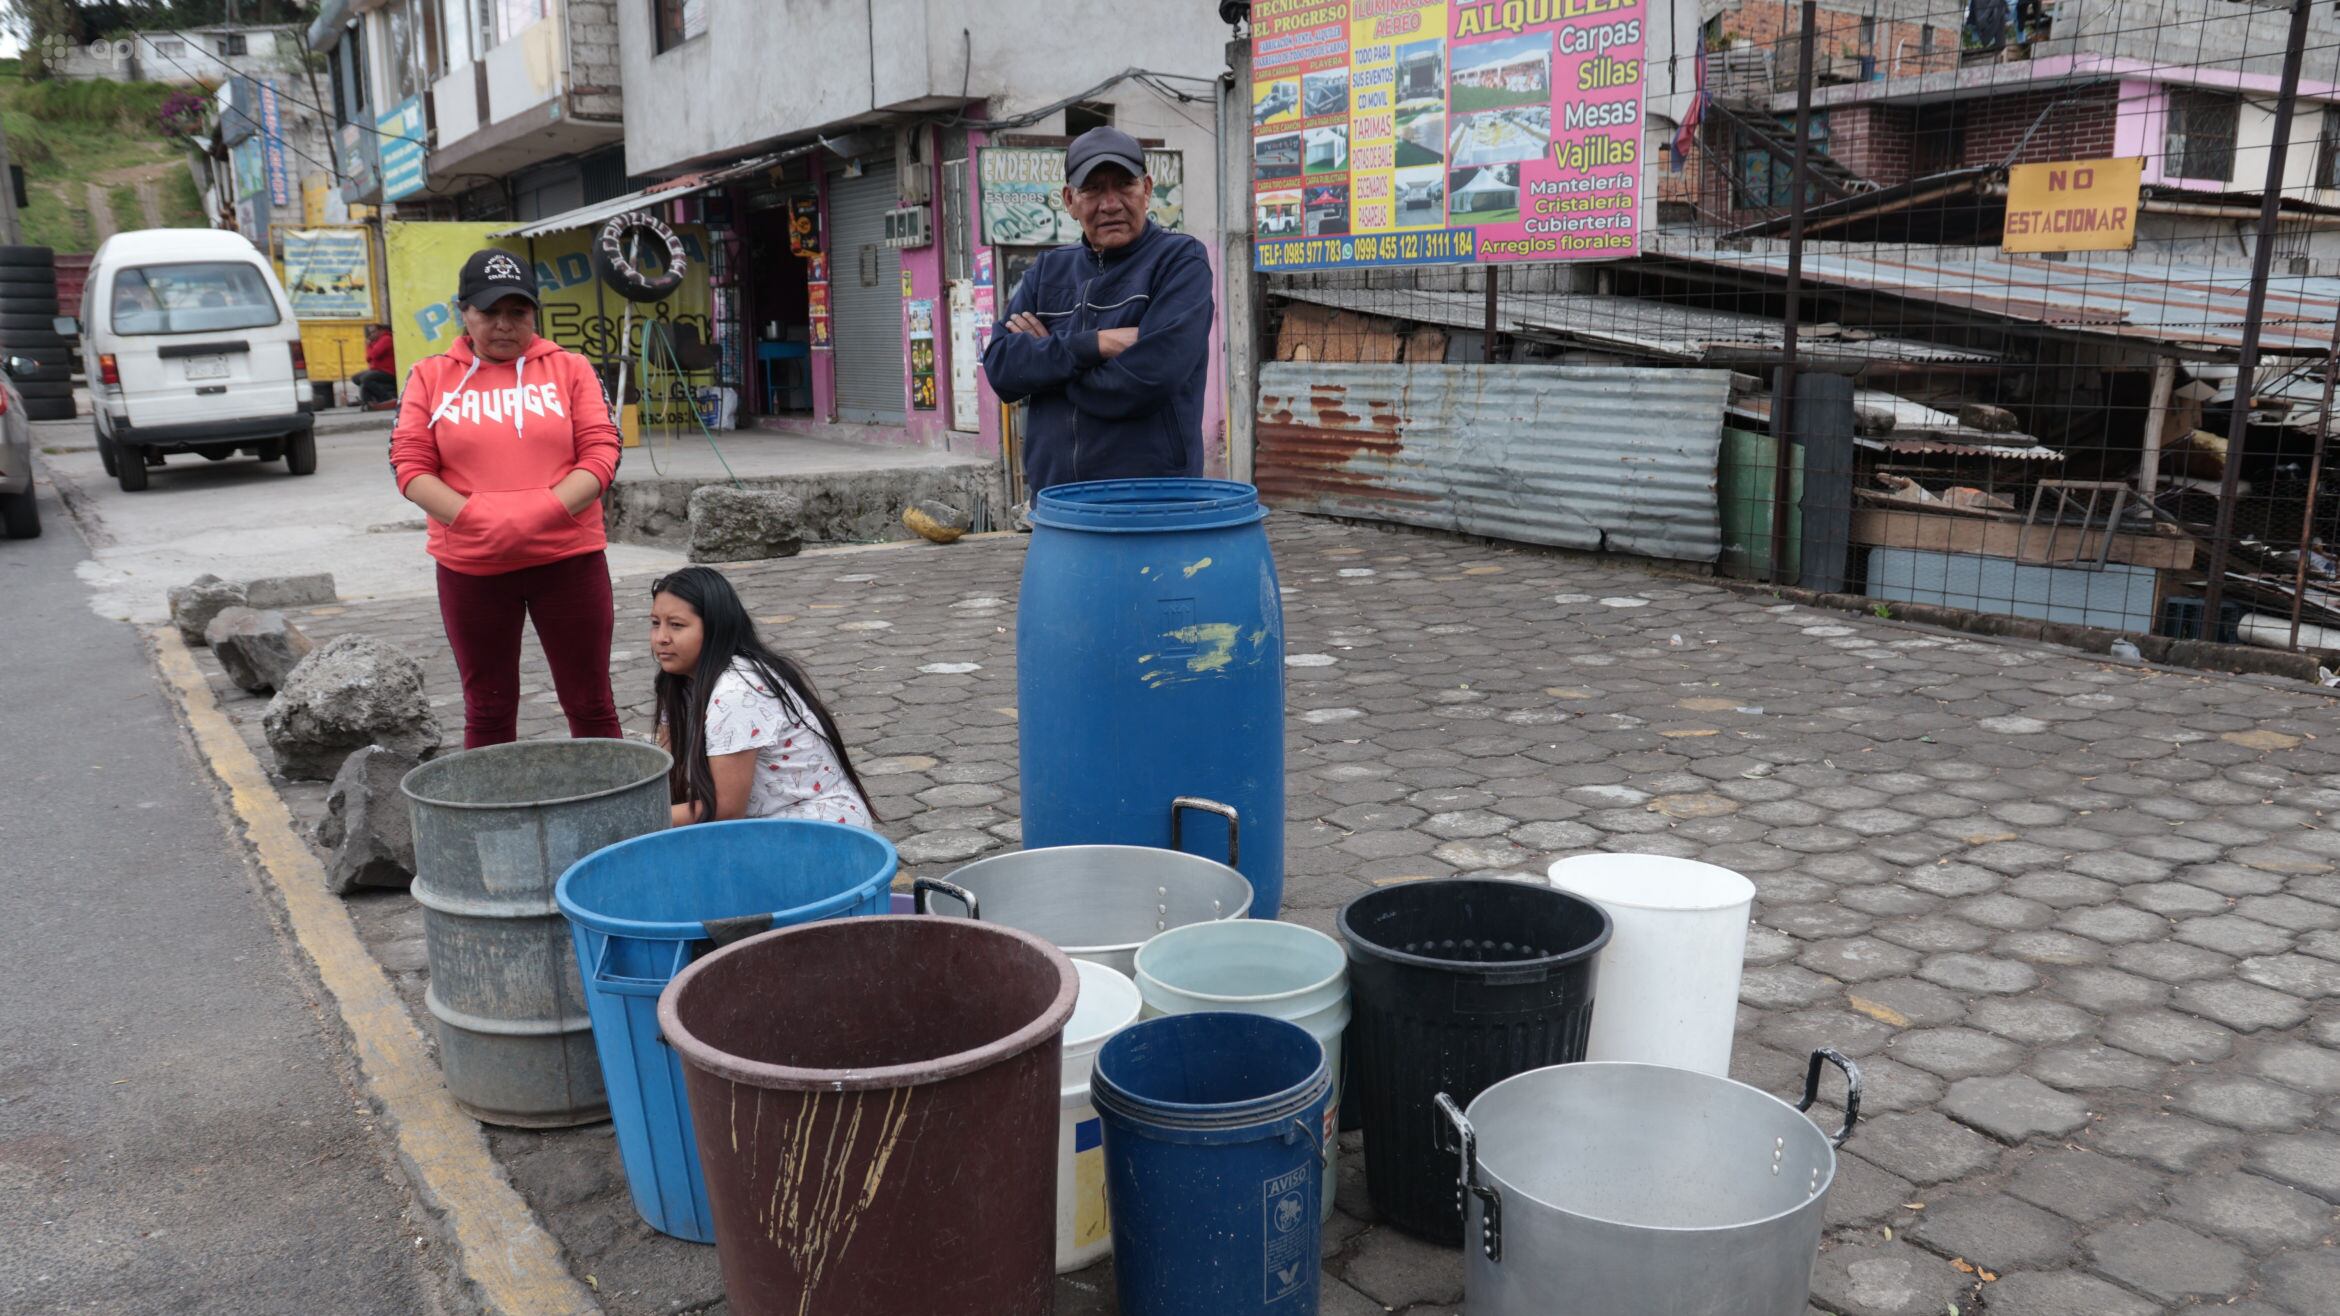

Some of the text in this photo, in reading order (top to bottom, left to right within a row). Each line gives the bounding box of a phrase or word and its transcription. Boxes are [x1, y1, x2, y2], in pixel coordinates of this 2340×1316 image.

[1253, 4, 1347, 38] EL PROGRESO
[1559, 19, 1641, 55] Carpas
[1310, 57, 1343, 69] PLAYERA
[1355, 44, 1391, 65] TODO PARA
[1352, 66, 1394, 88] SUS EVENTOS
[1578, 55, 1639, 91] Sillas
[1564, 99, 1637, 131] Mesas
[1353, 115, 1392, 140] TARIMAS
[1378, 144, 1392, 167] BAILE
[1553, 135, 1636, 174] Vajillas
[1357, 176, 1388, 199] ESCENARIOS
[1530, 172, 1633, 196] Mantelería
[2049, 168, 2094, 192] NO
[984, 189, 1045, 206] Escapes
[1535, 193, 1633, 214] Cristalería
[1524, 212, 1632, 233] Cubiertería
[2006, 207, 2128, 234] ESTACIONAR
[1259, 244, 1282, 266] TELF:
[1284, 242, 1305, 264] 0985
[1307, 241, 1323, 263] 977
[1325, 239, 1341, 262] 783
[1354, 237, 1377, 261] 0999
[1379, 235, 1398, 259] 455
[1400, 233, 1418, 258] 122
[1425, 232, 1450, 257] 3111
[1453, 230, 1473, 256] 184
[1480, 233, 1633, 255] Arreglos florales
[1270, 1167, 1307, 1195] AVISO
